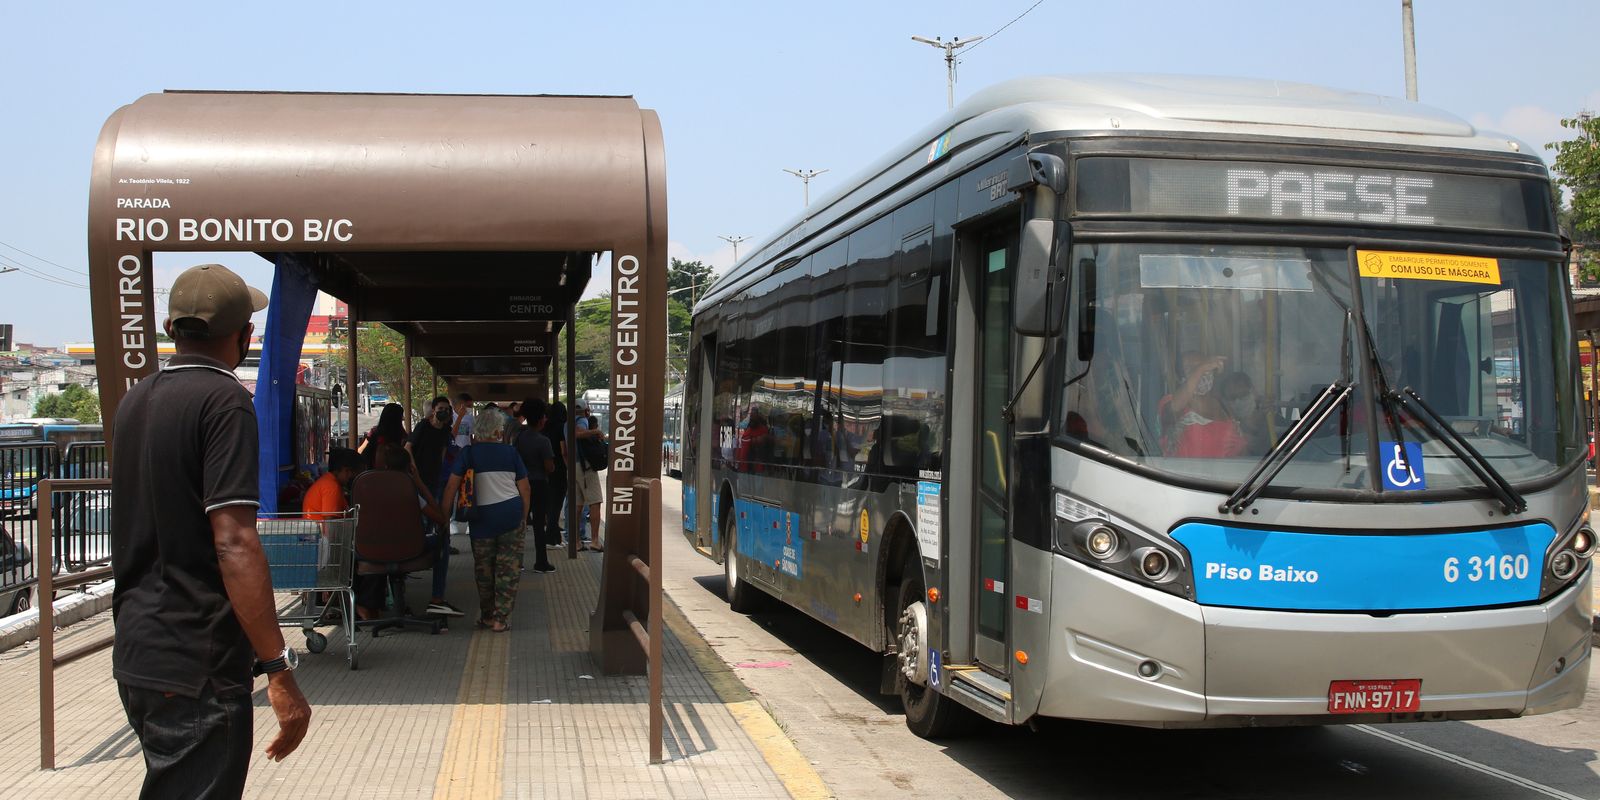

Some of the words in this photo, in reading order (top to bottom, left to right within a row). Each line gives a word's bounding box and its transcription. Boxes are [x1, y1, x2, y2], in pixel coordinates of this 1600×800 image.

[117, 198, 171, 209] PARADA
[1227, 169, 1434, 225] PAESE
[116, 218, 169, 242] RIO
[179, 218, 294, 242] BONITO
[303, 219, 353, 242] B/C
[1389, 256, 1425, 264] EMBARQUE
[1426, 258, 1459, 266] PERMITIDO
[1391, 265, 1412, 274] COM
[1414, 266, 1433, 275] USO
[1435, 267, 1446, 276] DE
[1448, 267, 1490, 279] MÁSCARA
[118, 254, 146, 369] CENTRO
[510, 304, 553, 314] CENTRO
[616, 254, 639, 366] CENTRO
[1205, 562, 1252, 580] Piso
[1259, 565, 1319, 583] Baixo
[1444, 557, 1459, 583] 6
[1467, 554, 1529, 582] 3160
